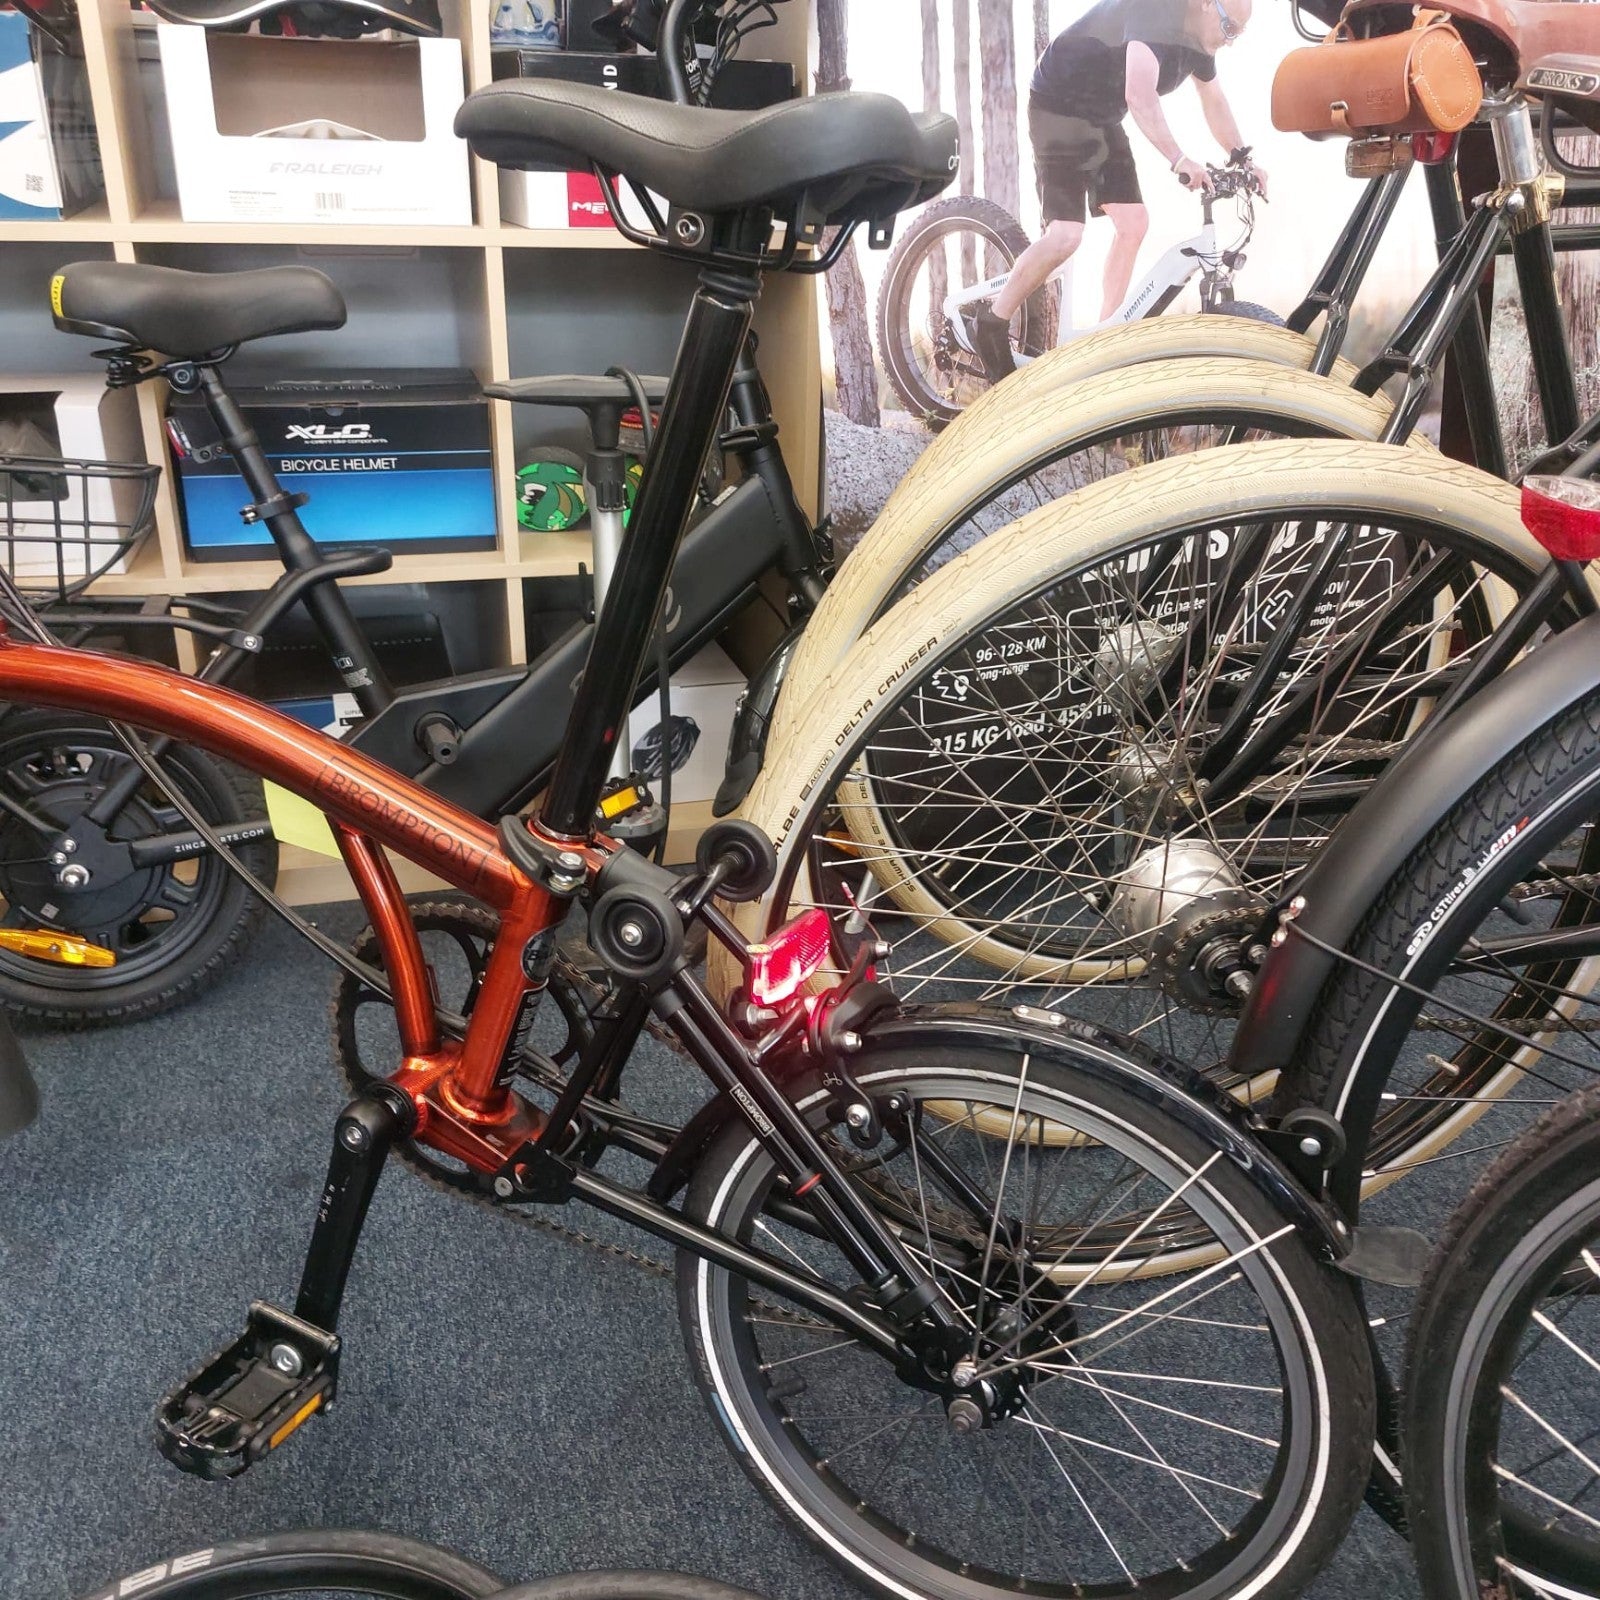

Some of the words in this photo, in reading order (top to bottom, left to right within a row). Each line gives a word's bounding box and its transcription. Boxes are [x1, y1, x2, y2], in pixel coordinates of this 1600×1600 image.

[1539, 70, 1583, 90] BROOKS
[572, 202, 609, 214] ME
[1123, 280, 1156, 322] HIMIWAY
[285, 424, 370, 439] XLC
[281, 459, 341, 472] BICYCLE
[343, 457, 398, 470] HELMET
[1026, 635, 1047, 652] KM
[809, 754, 833, 786] ACTIVE
[835, 698, 873, 747] DELTA
[877, 636, 938, 697] CRUISER
[971, 725, 999, 749] KG
[329, 770, 477, 868] BROMPTON
[174, 826, 266, 853] ZINCSRTS.COM
[1489, 824, 1517, 855] CITY
[734, 1088, 771, 1132] BROMPTON
